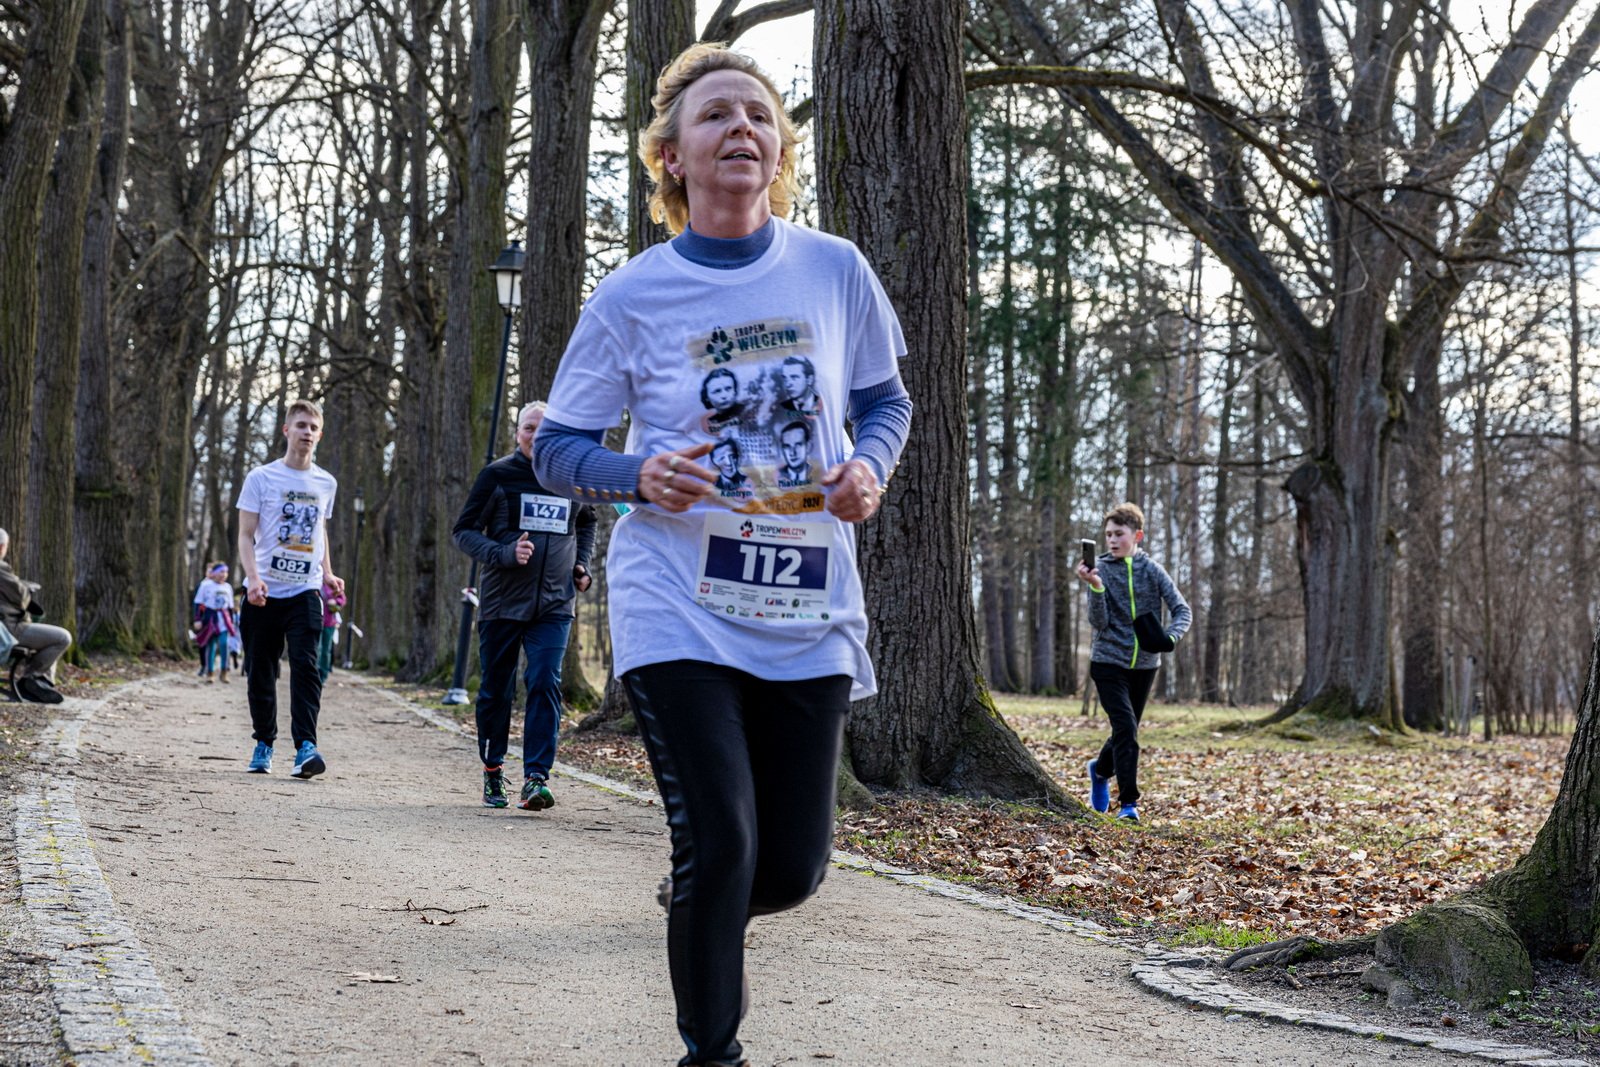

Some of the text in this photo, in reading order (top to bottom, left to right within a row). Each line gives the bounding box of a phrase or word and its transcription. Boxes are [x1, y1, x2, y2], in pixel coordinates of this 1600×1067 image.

[734, 324, 766, 337] TROPEM
[737, 330, 798, 351] WILCZYM
[803, 496, 820, 509] 2024
[531, 504, 560, 518] 147
[276, 559, 306, 573] 082
[740, 544, 802, 585] 112
